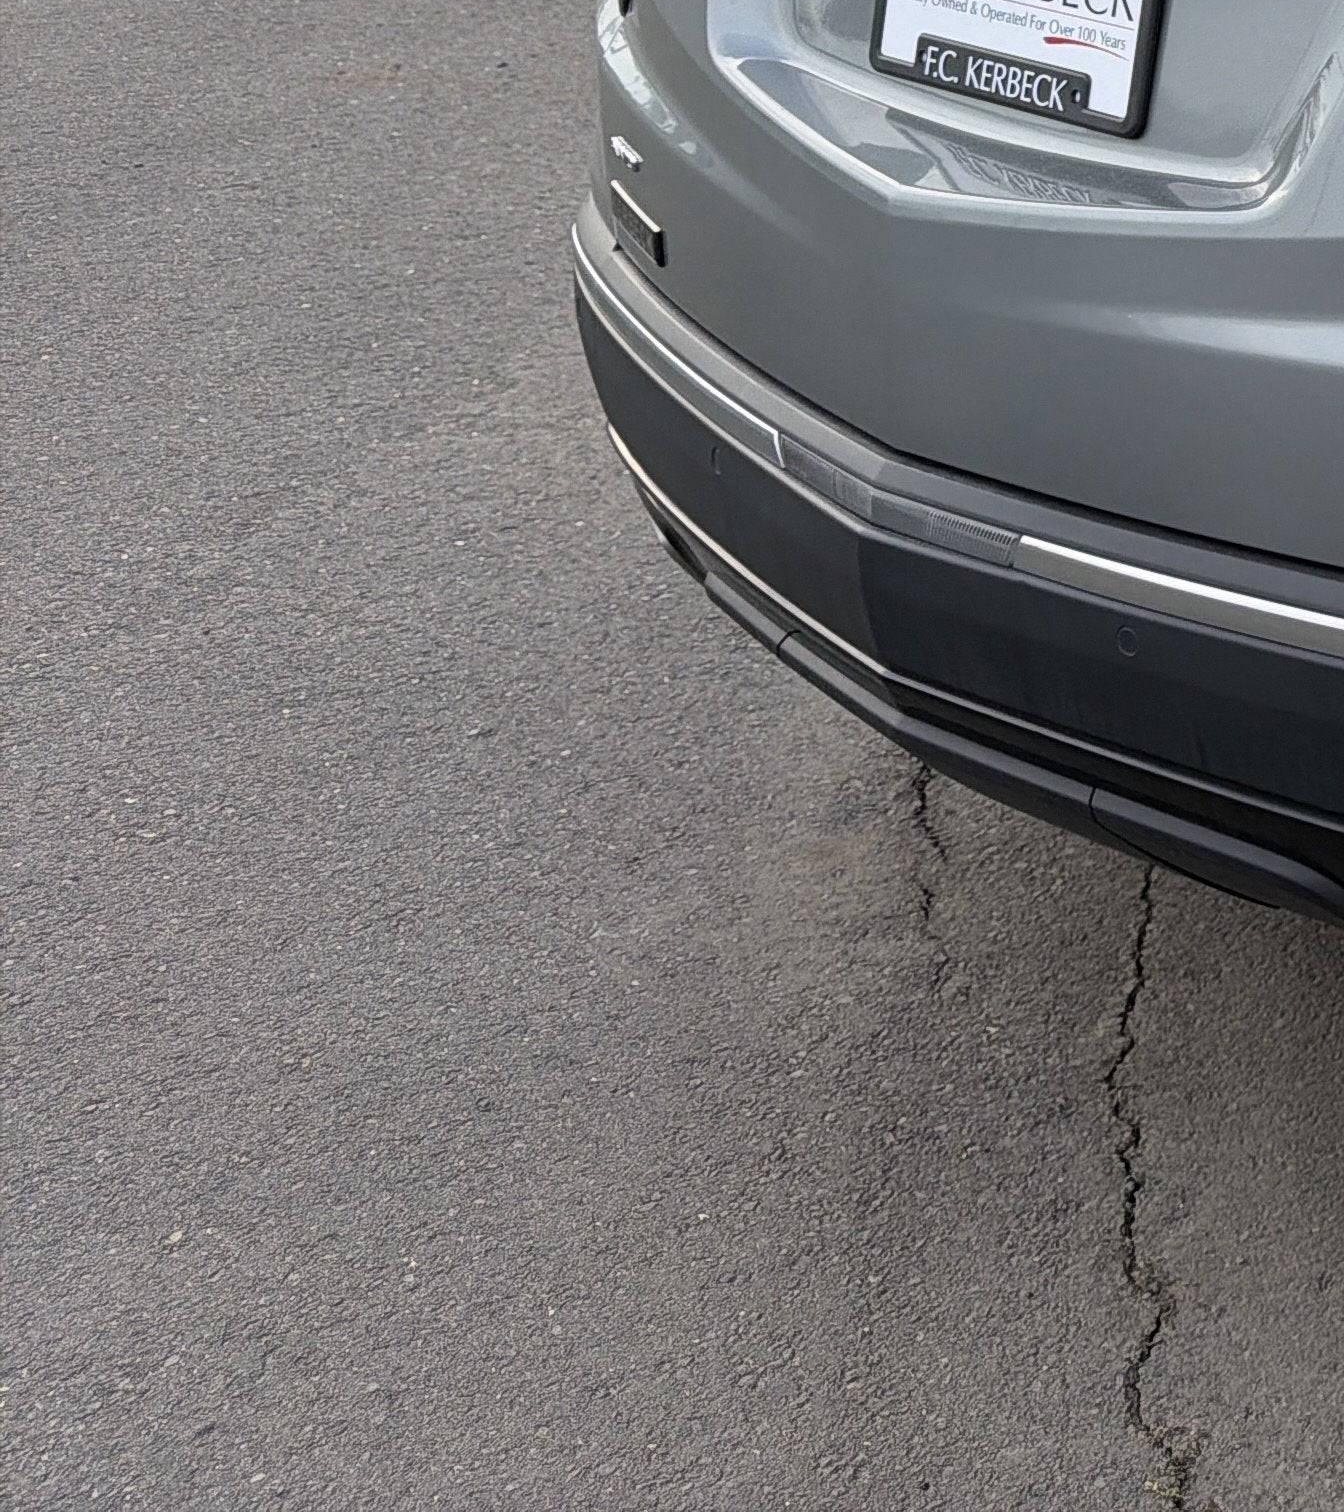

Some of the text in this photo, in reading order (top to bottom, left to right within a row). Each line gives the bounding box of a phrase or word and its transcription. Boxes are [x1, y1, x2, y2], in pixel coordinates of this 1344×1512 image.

[970, 0, 979, 16] &
[980, 3, 1028, 29] Operated
[1029, 14, 1046, 31] For
[1049, 19, 1075, 38] Over
[1077, 25, 1097, 43] 100
[1100, 31, 1127, 51] Years
[923, 45, 1069, 112] F.C. KERBECK
